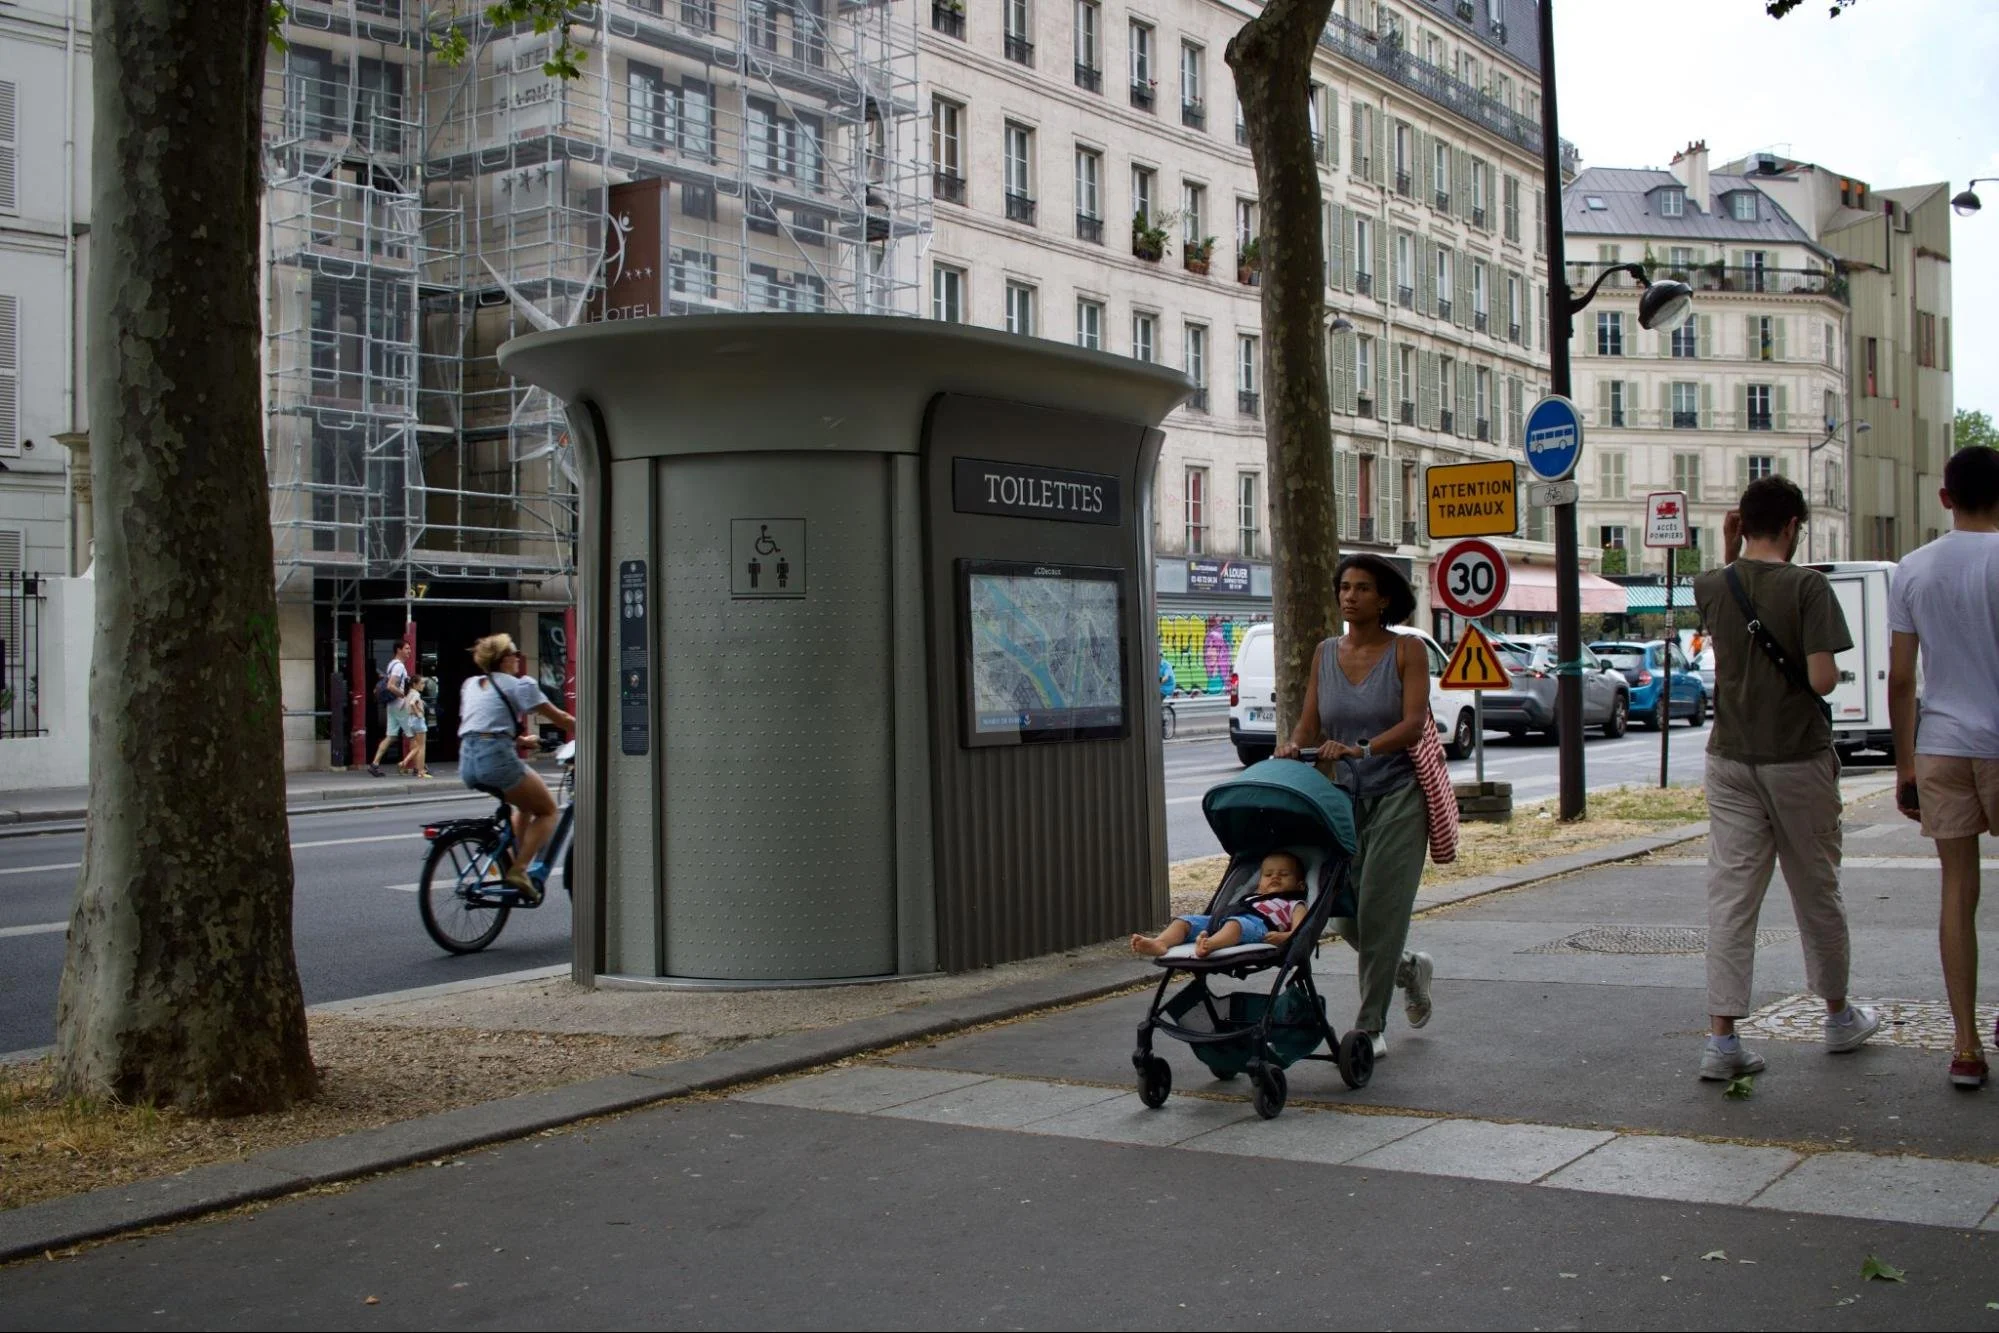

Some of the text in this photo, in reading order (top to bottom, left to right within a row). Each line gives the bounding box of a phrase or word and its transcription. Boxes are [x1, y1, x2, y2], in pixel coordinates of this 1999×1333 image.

[591, 303, 657, 323] HOTEL
[984, 473, 1103, 513] TOILETTES
[1432, 480, 1512, 499] ATTENTION
[1438, 500, 1505, 518] TRAVAUX
[1229, 567, 1248, 579] LOUER
[1451, 561, 1494, 596] 30
